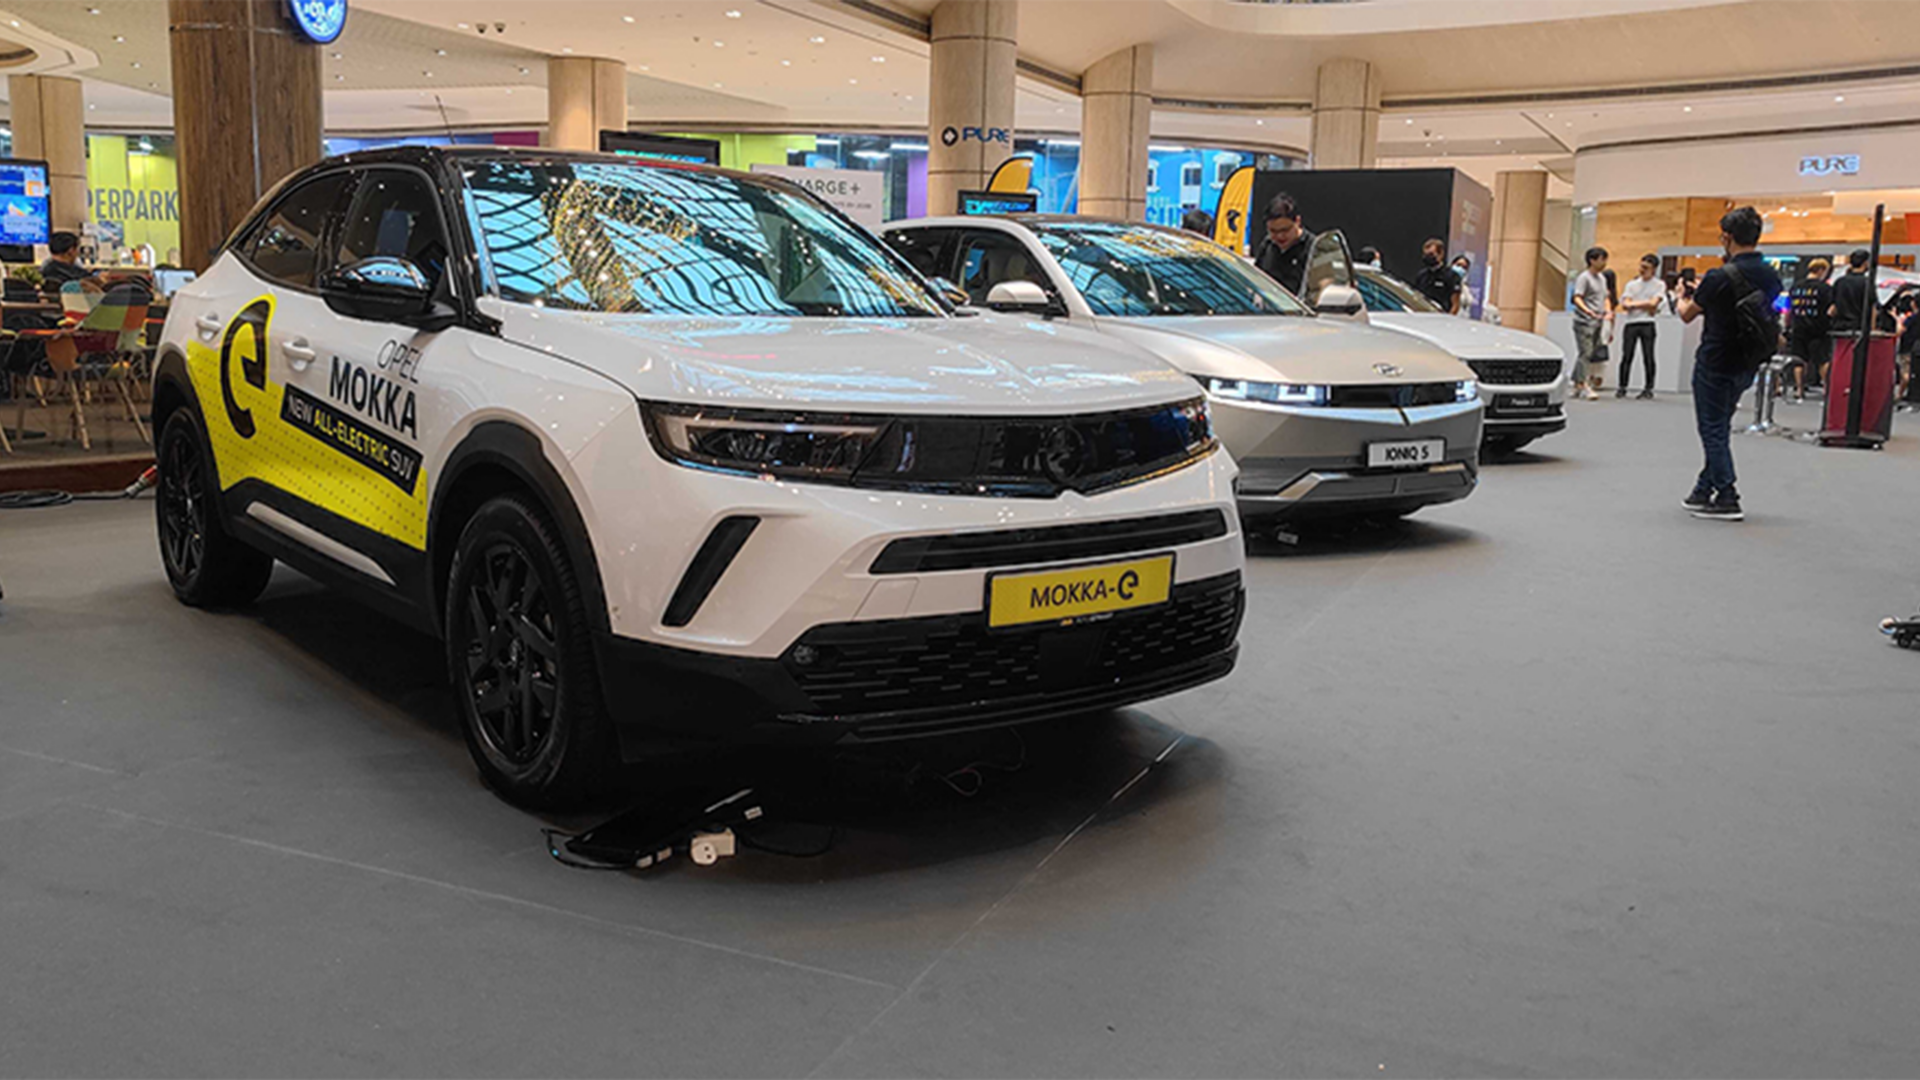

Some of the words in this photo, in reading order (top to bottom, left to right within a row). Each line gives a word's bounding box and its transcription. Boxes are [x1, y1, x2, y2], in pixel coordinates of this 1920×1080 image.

[962, 127, 1010, 143] PURE
[1798, 155, 1859, 174] PURE
[377, 339, 423, 385] OPEL
[329, 355, 418, 441] MOKKA
[288, 394, 313, 425] NEW
[313, 408, 390, 467] ALL-ELECTRIC
[390, 448, 415, 480] SUV
[1385, 447, 1419, 461] IONIQ
[1421, 446, 1430, 459] 5
